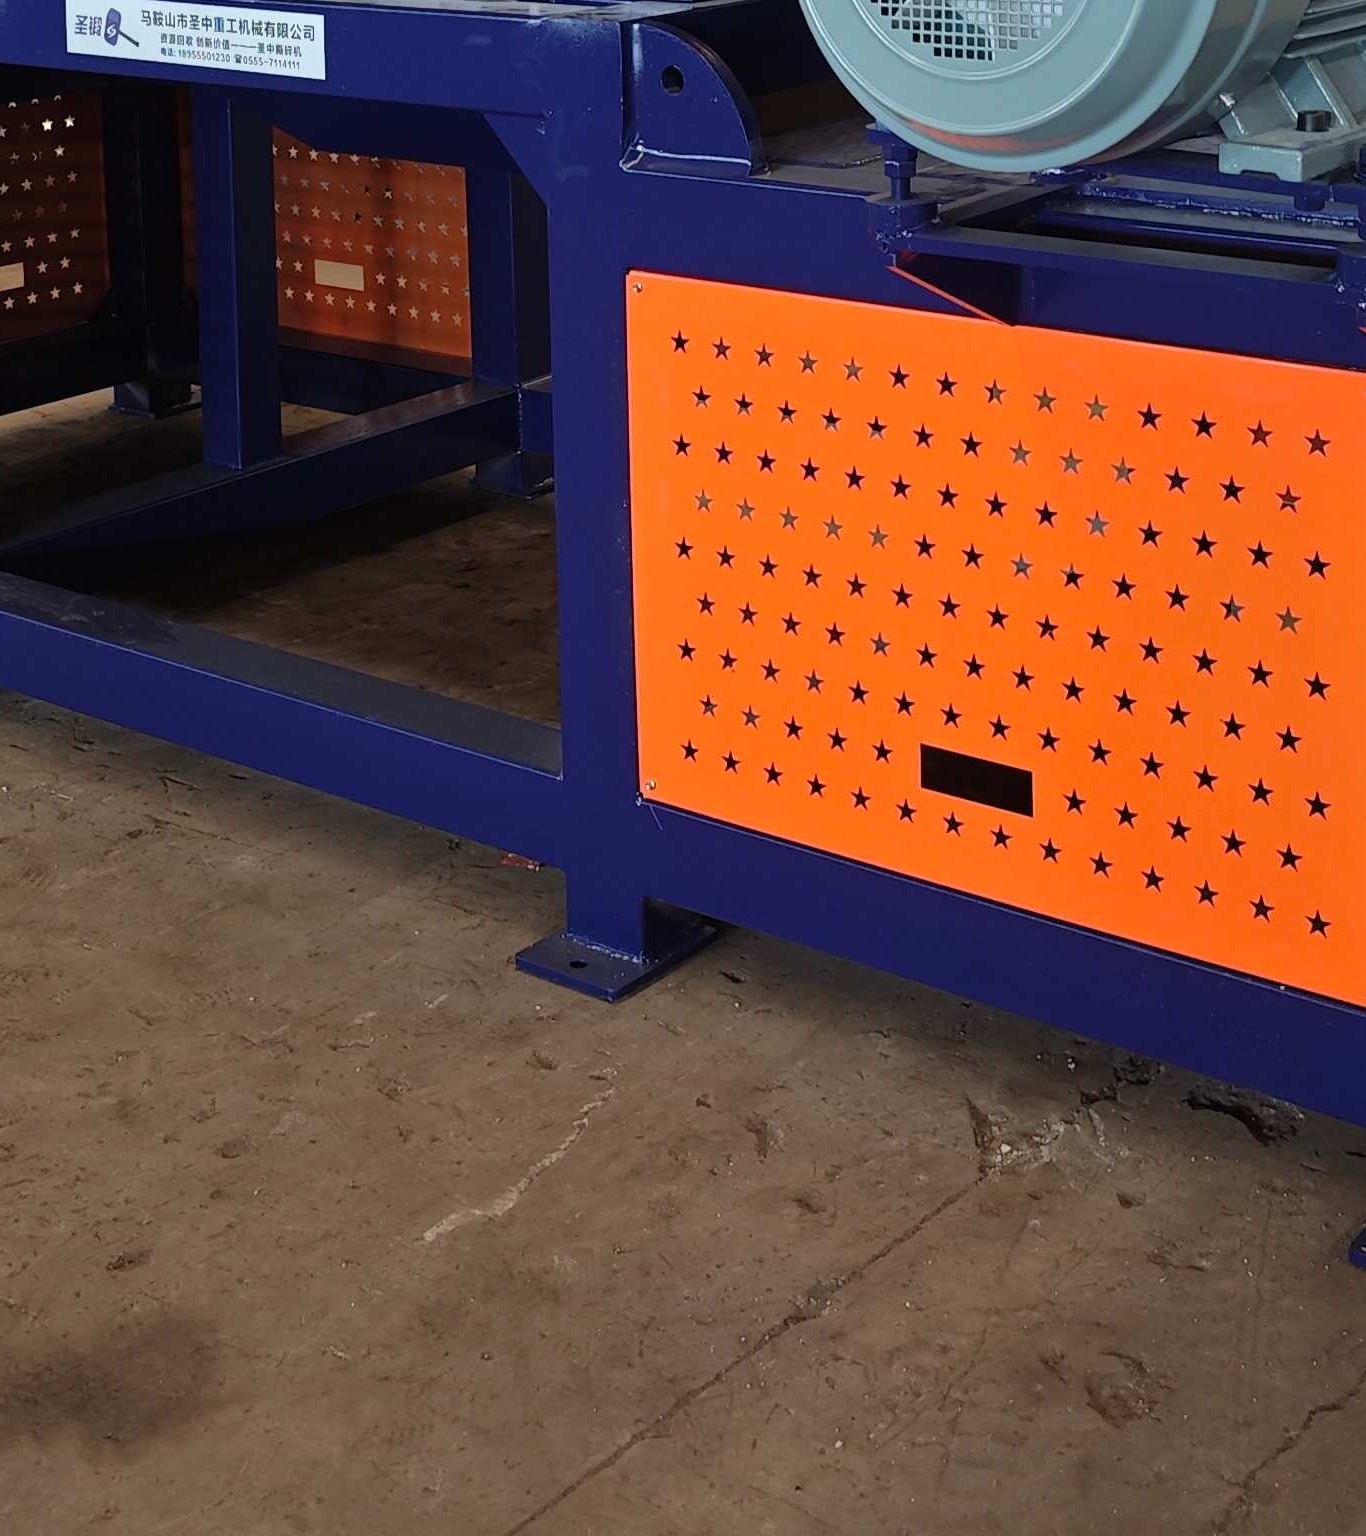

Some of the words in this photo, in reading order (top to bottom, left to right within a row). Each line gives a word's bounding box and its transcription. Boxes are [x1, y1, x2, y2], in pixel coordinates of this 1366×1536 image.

[140, 10, 315, 42] 马鞍山市圣中重工机械有限公司
